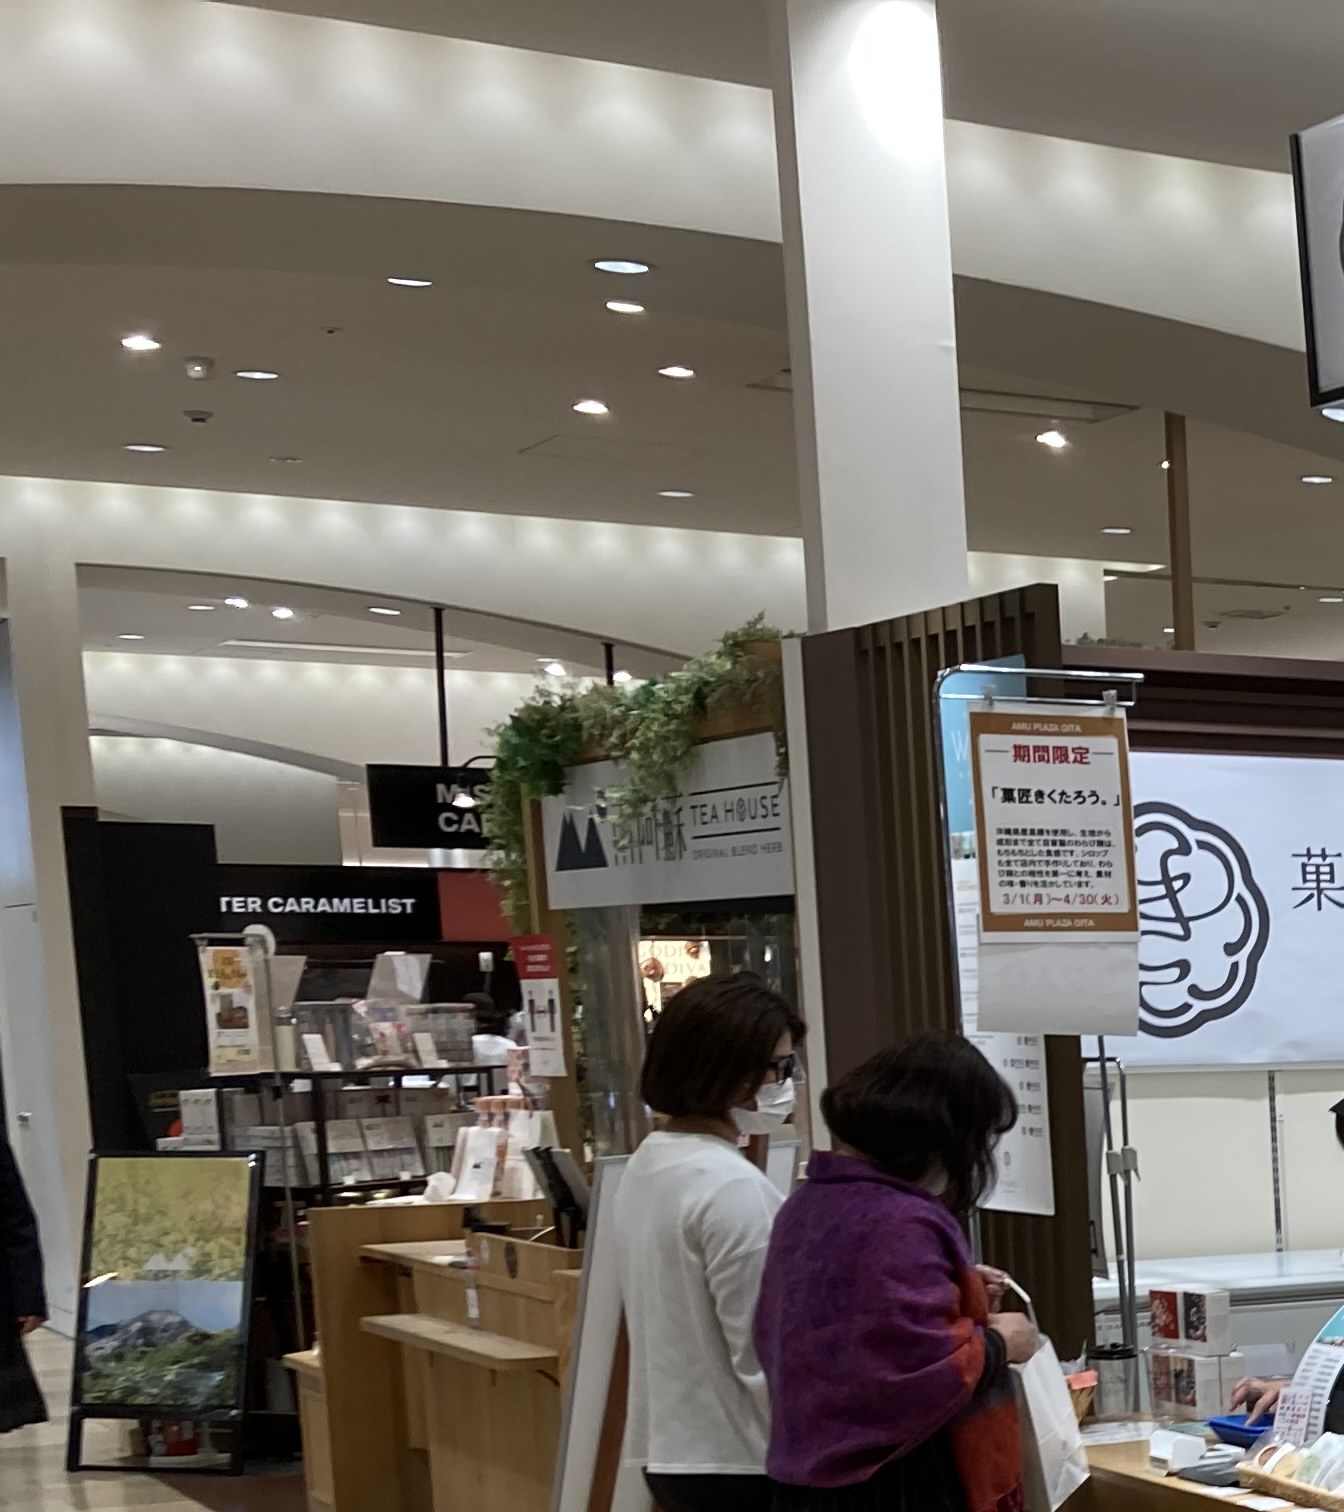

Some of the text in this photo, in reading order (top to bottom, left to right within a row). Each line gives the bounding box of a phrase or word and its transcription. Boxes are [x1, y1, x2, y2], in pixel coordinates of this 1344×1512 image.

[1011, 722, 1082, 733] AMU PLAZA OITA
[1012, 743, 1091, 765] 期間限定
[689, 802, 719, 828] TEA
[267, 896, 417, 915] CARAMELIST
[1023, 918, 1095, 928] AMU PLAZA OITA
